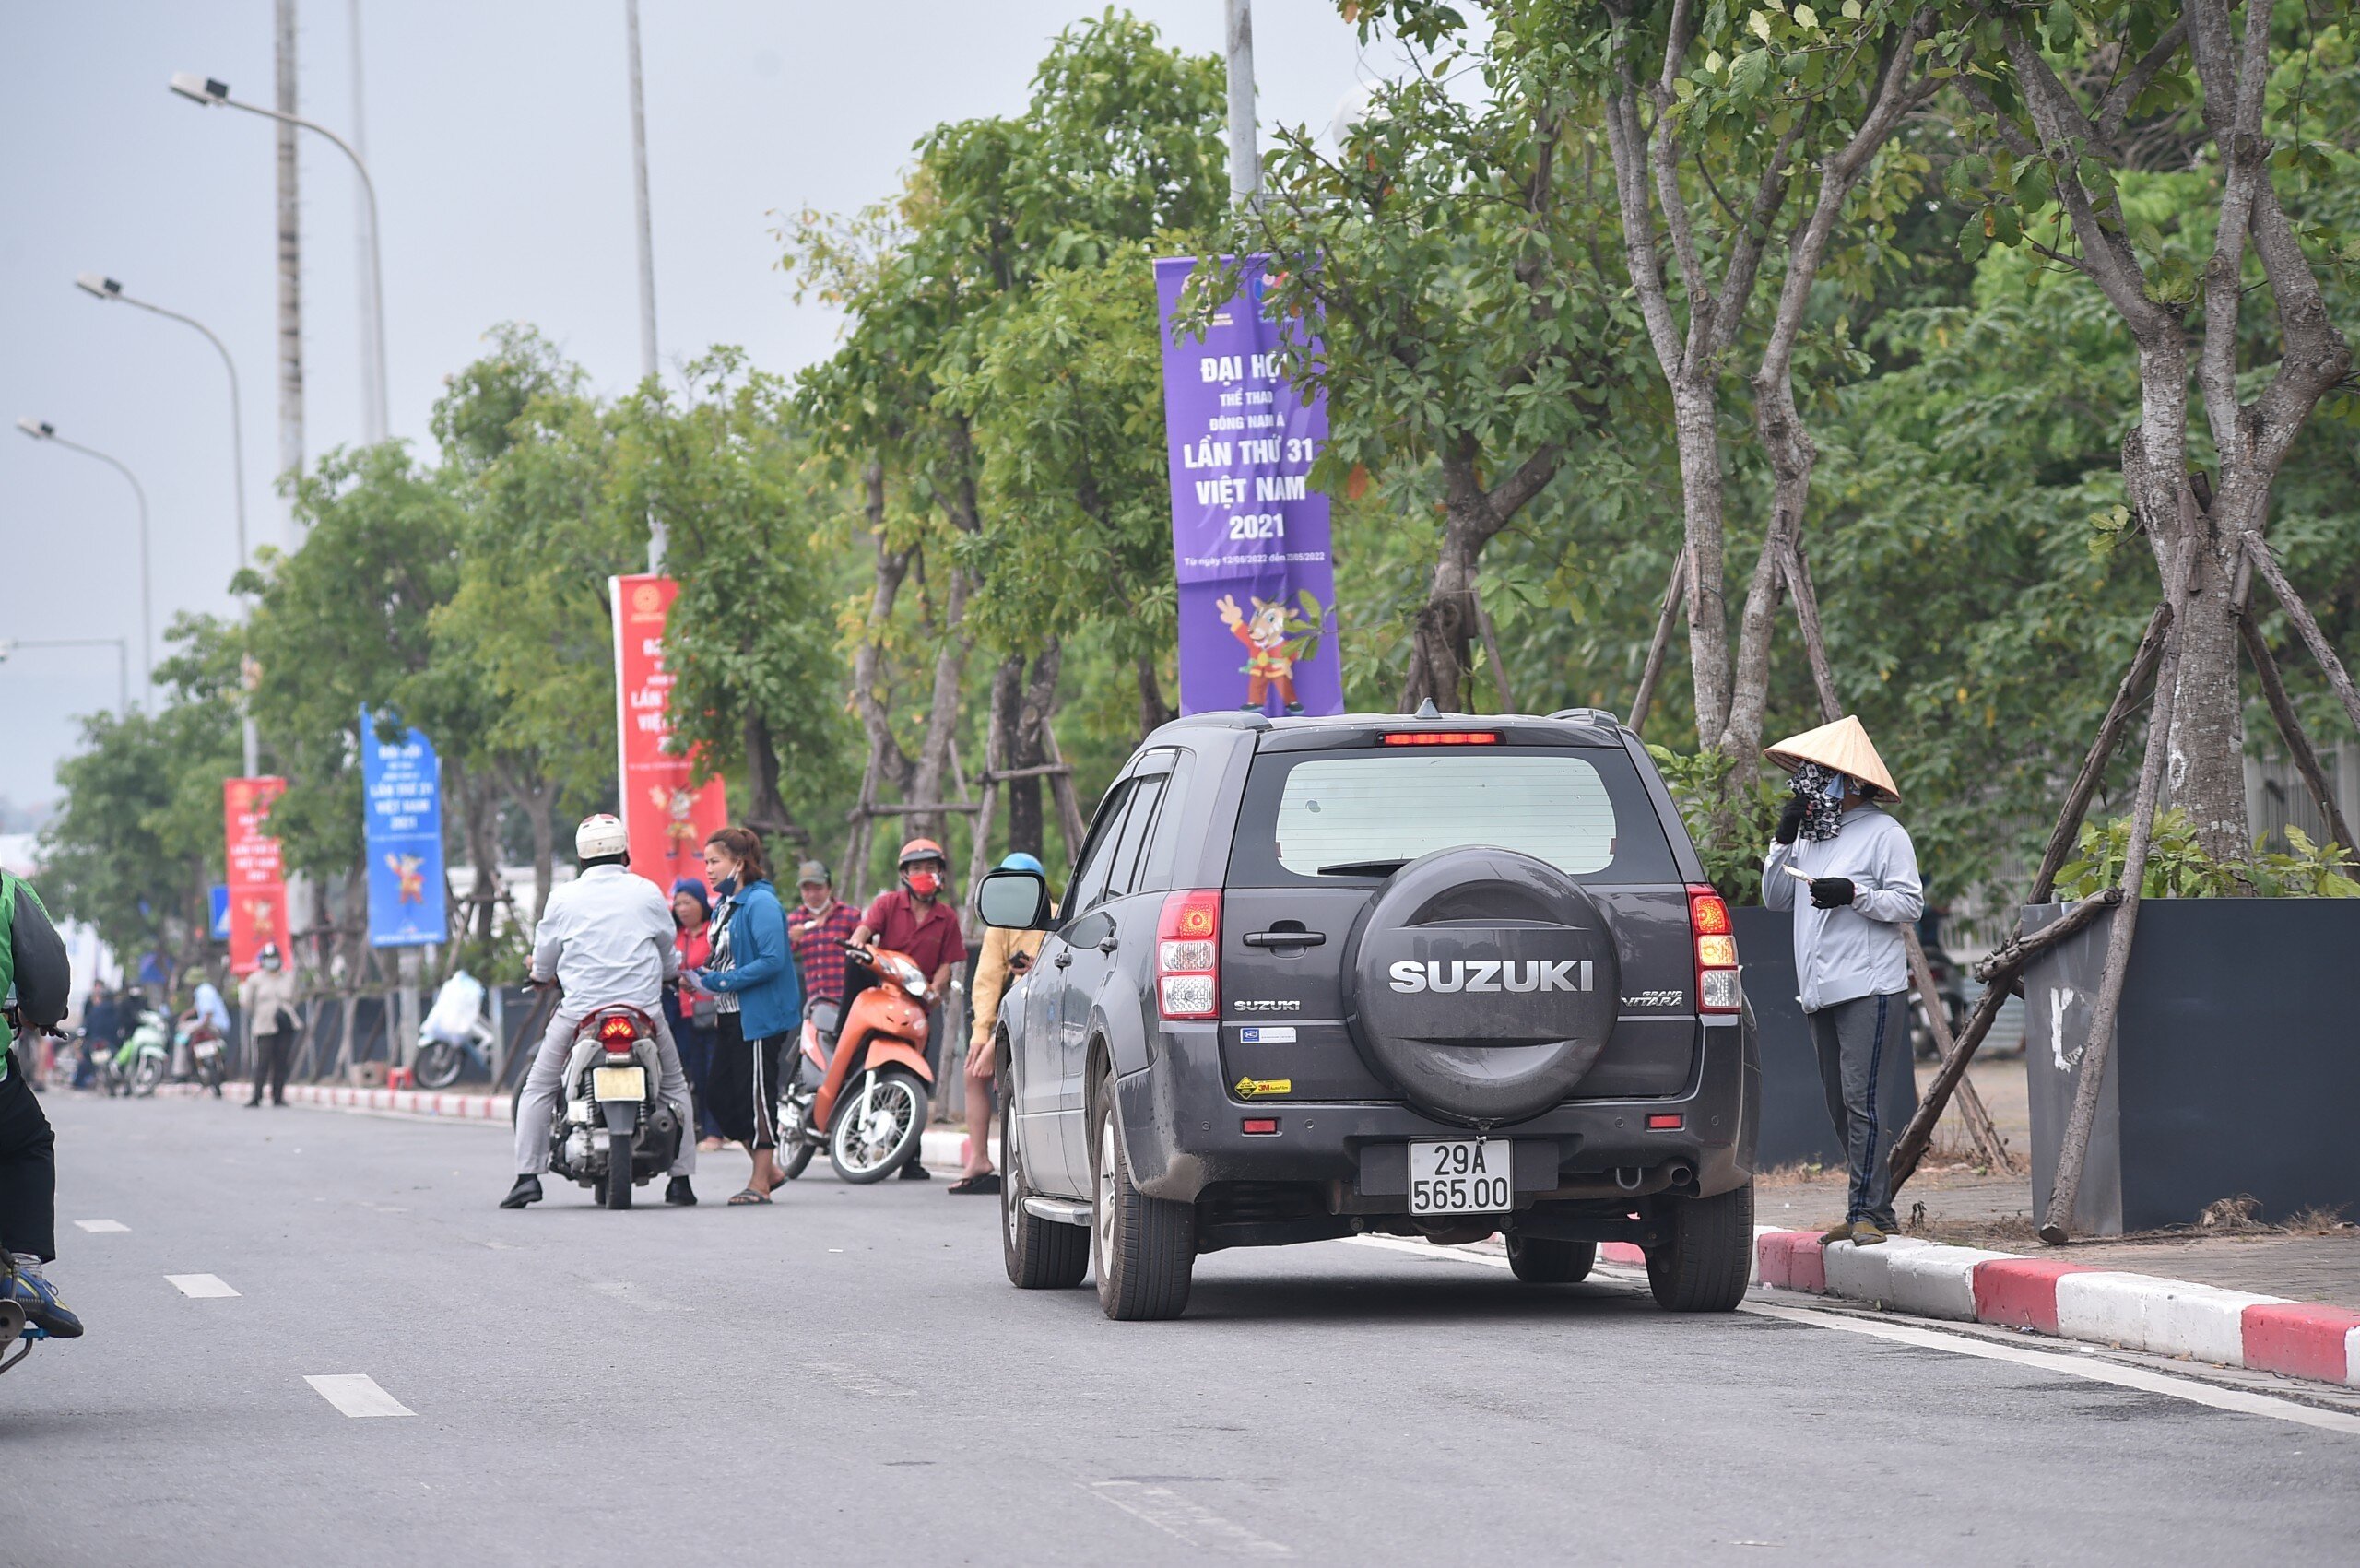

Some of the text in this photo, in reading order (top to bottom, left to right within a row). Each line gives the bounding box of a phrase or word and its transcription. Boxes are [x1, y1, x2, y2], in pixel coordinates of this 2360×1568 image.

[1200, 355, 1243, 387] ĐẠI
[1219, 387, 1273, 407] THỂ THAO
[1247, 414, 1274, 428] NAM
[1183, 433, 1313, 468] LẦN THỨ 31
[1195, 475, 1306, 509] VIỆT NAM
[1229, 513, 1284, 540] 2021
[1388, 960, 1593, 994] SUZUKI
[1233, 1000, 1301, 1011] SUZUKI
[1621, 996, 1683, 1008] VITARA
[1434, 1144, 1487, 1175] 29A
[1413, 1177, 1508, 1210] 565.00
